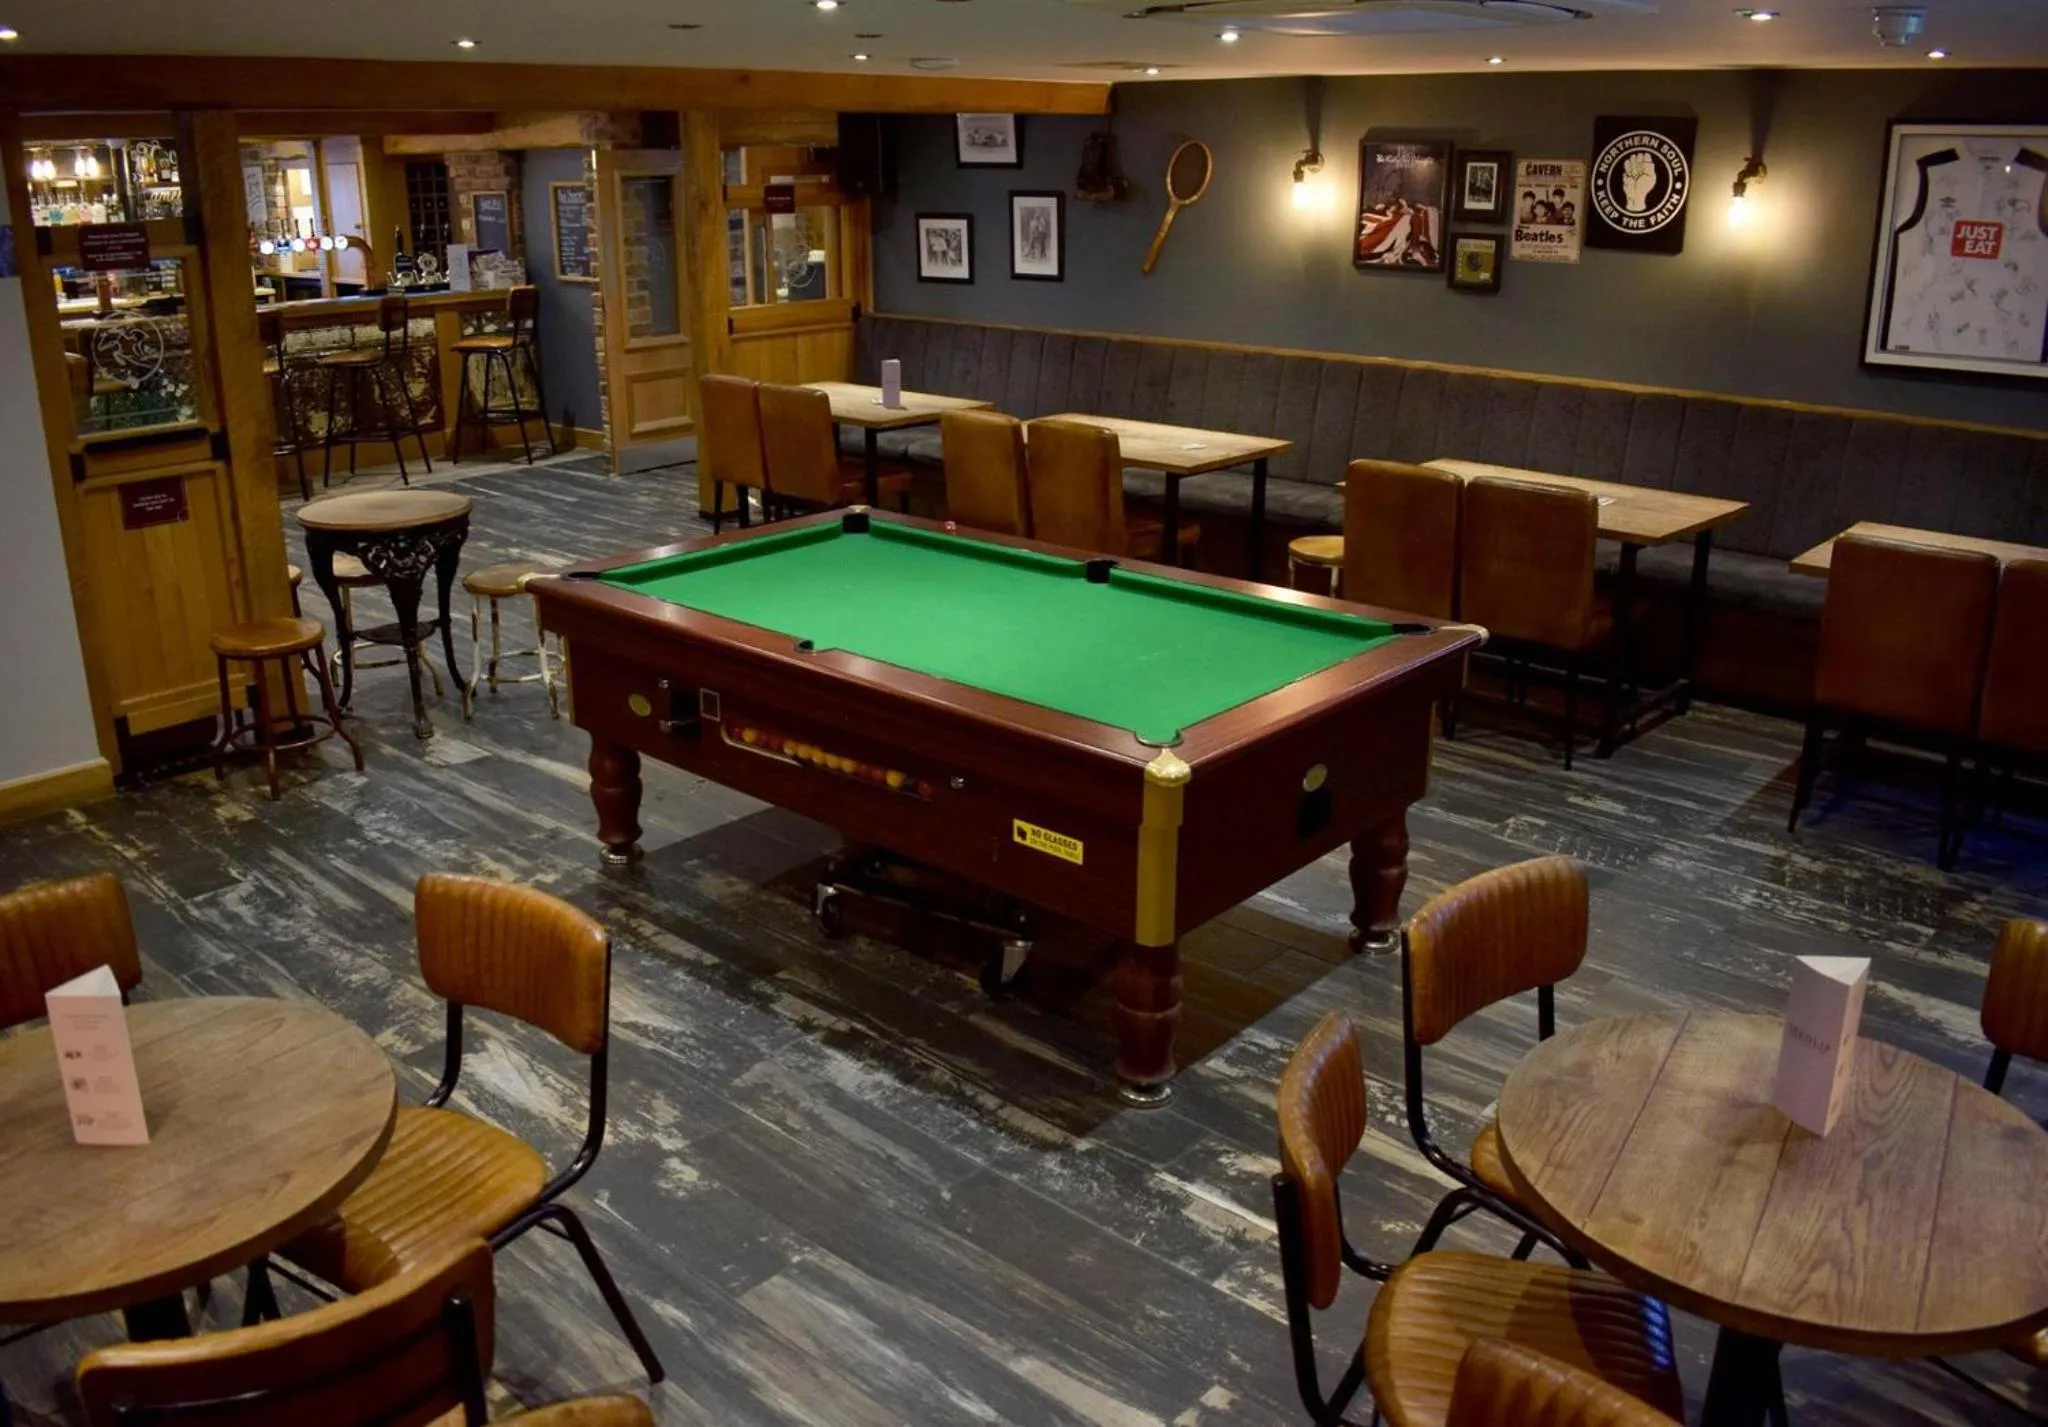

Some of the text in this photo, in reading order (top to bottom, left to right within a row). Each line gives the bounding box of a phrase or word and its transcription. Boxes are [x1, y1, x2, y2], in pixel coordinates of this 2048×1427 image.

[1599, 135, 1683, 176] NORTHERN SOUL
[1526, 163, 1562, 176] CAVERN
[1596, 190, 1681, 228] KEEP THE FAITH
[1515, 229, 1564, 244] Beatles
[1956, 225, 1999, 240] JUST
[1964, 240, 1997, 255] EAT
